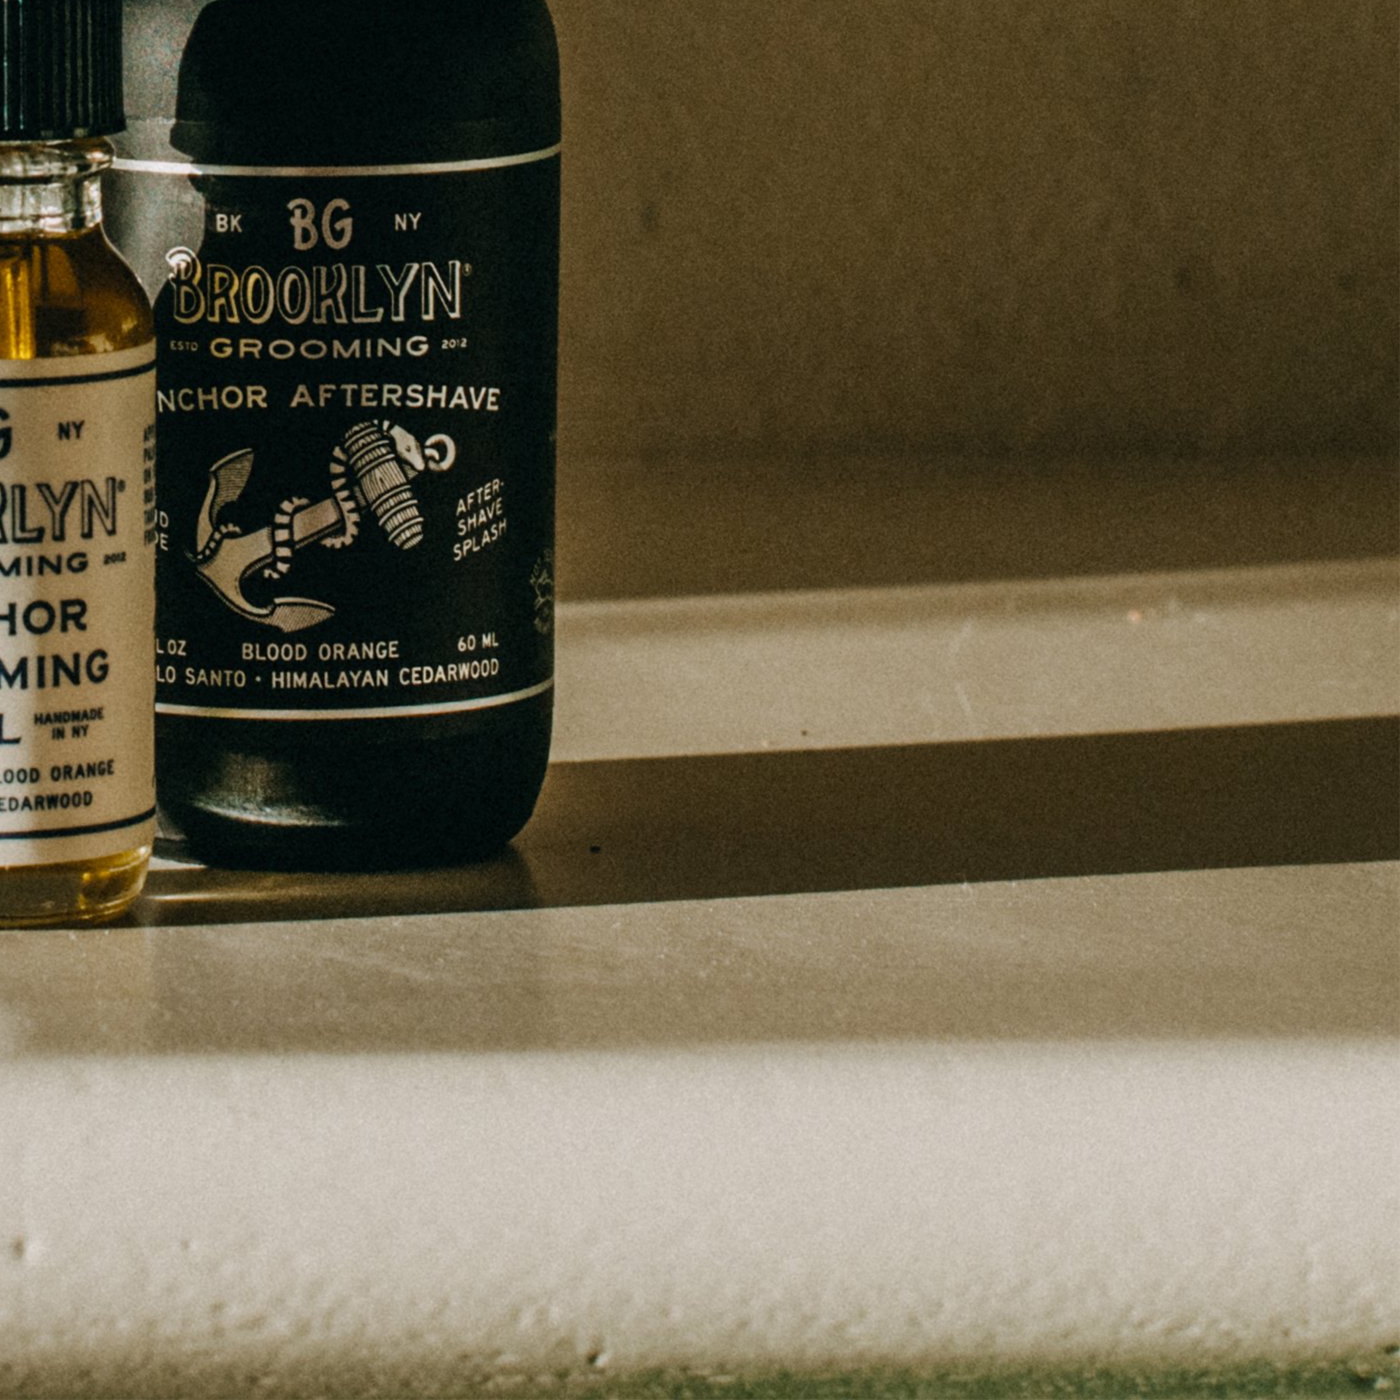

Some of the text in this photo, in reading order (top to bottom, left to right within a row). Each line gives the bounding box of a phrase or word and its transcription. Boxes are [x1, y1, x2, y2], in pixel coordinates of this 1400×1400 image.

[215, 197, 422, 251] BK BG NY
[170, 340, 198, 351] ESTD
[209, 336, 429, 359] GROOMING
[157, 384, 500, 413] NCHOR AFTERSHAVE
[58, 420, 85, 441] NY
[457, 497, 503, 536] SHAVE
[453, 518, 507, 562] SPLASH
[167, 639, 187, 656] OZ
[242, 640, 400, 661] BLOOD ORANGE
[457, 633, 499, 652] 60 ML
[156, 658, 500, 689] LO SANTO HIMALAYAN CEDARWOOD
[34, 706, 104, 726] HANDMADE
[52, 724, 89, 740] IN NY
[51, 759, 115, 782] ORANGE
